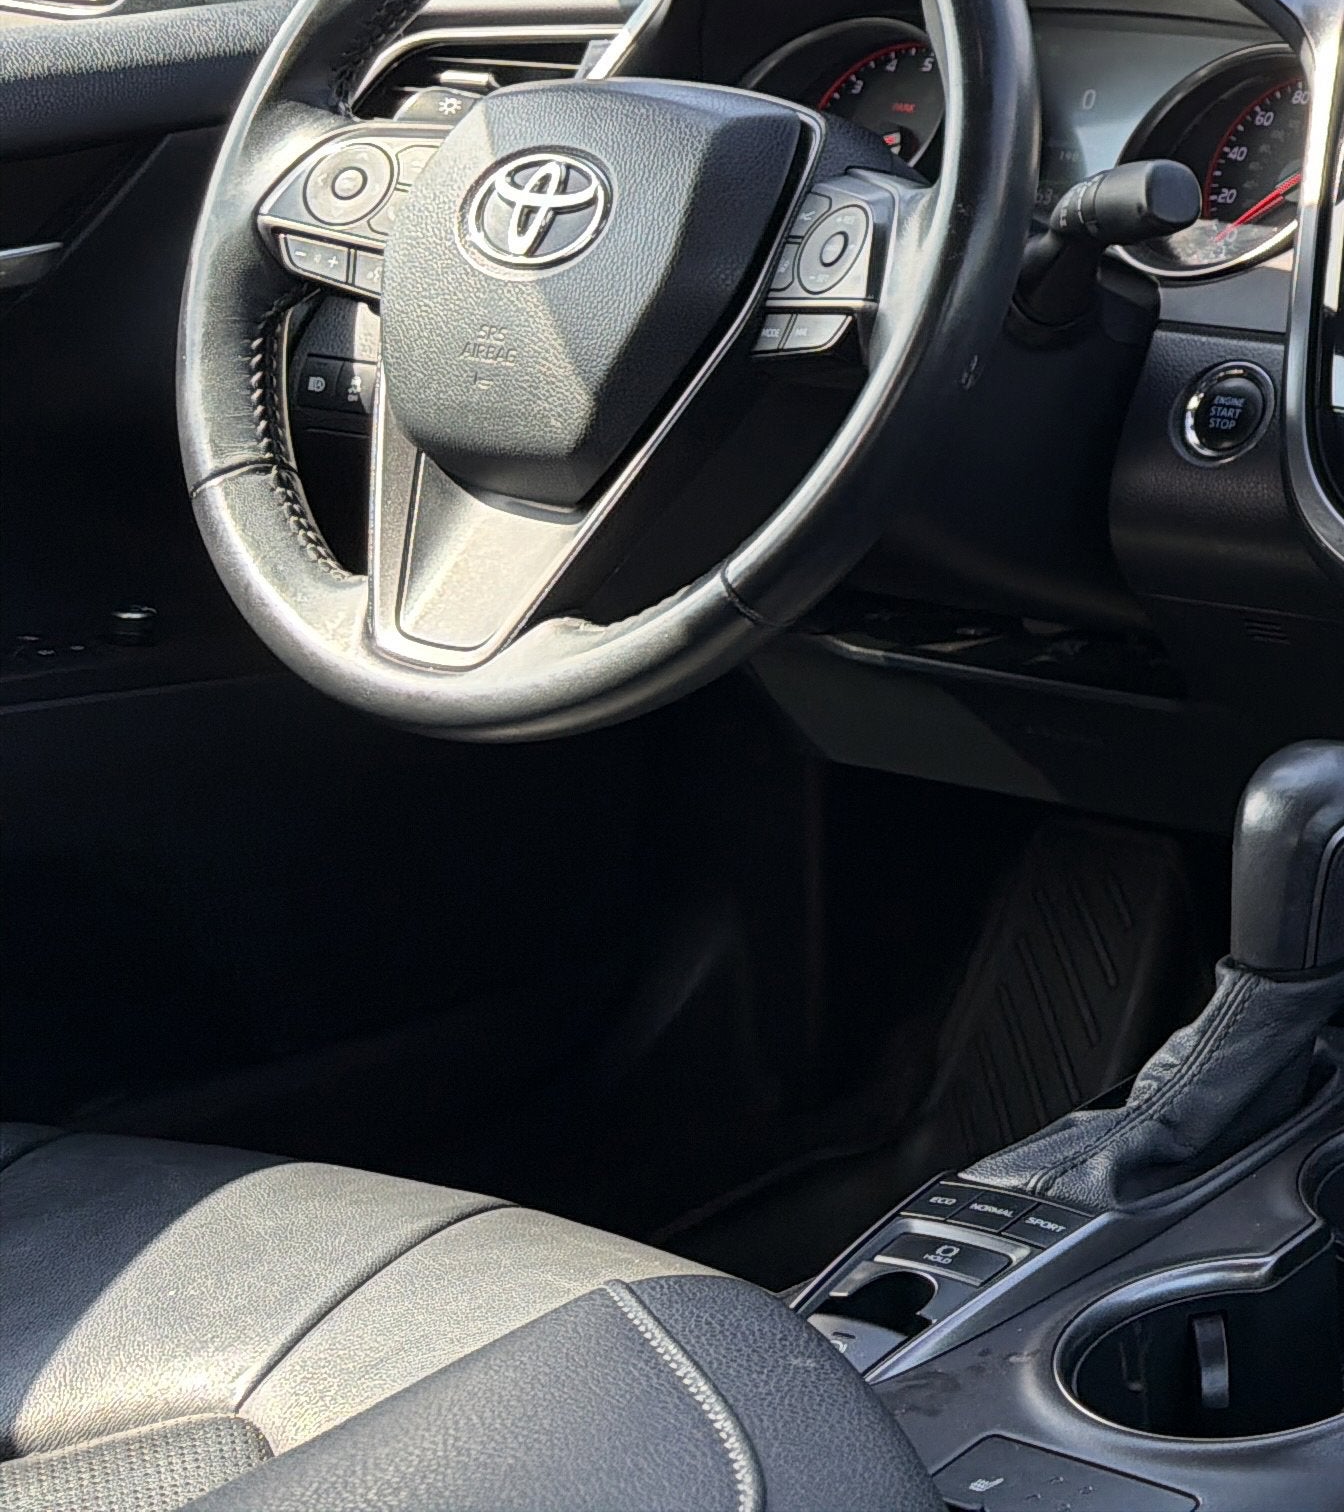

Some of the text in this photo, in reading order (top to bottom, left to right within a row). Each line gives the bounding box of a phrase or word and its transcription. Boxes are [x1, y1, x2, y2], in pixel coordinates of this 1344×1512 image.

[885, 59, 898, 73] 4
[920, 57, 934, 72] 5
[851, 79, 864, 95] 3
[1082, 88, 1097, 110] 0
[1291, 89, 1310, 105] 80
[1255, 111, 1275, 127] 60
[1227, 146, 1248, 161] 40
[1217, 188, 1237, 204] 20
[477, 324, 507, 341] SRS
[460, 341, 518, 363] AIRBAG
[1214, 394, 1246, 406] ENGINE
[1209, 406, 1242, 419] START
[1208, 417, 1236, 430] STOP
[929, 1196, 956, 1206] ECO
[970, 1202, 1014, 1218] NORMAL
[1025, 1216, 1065, 1233] SPORT
[924, 1254, 952, 1265] HOLD
